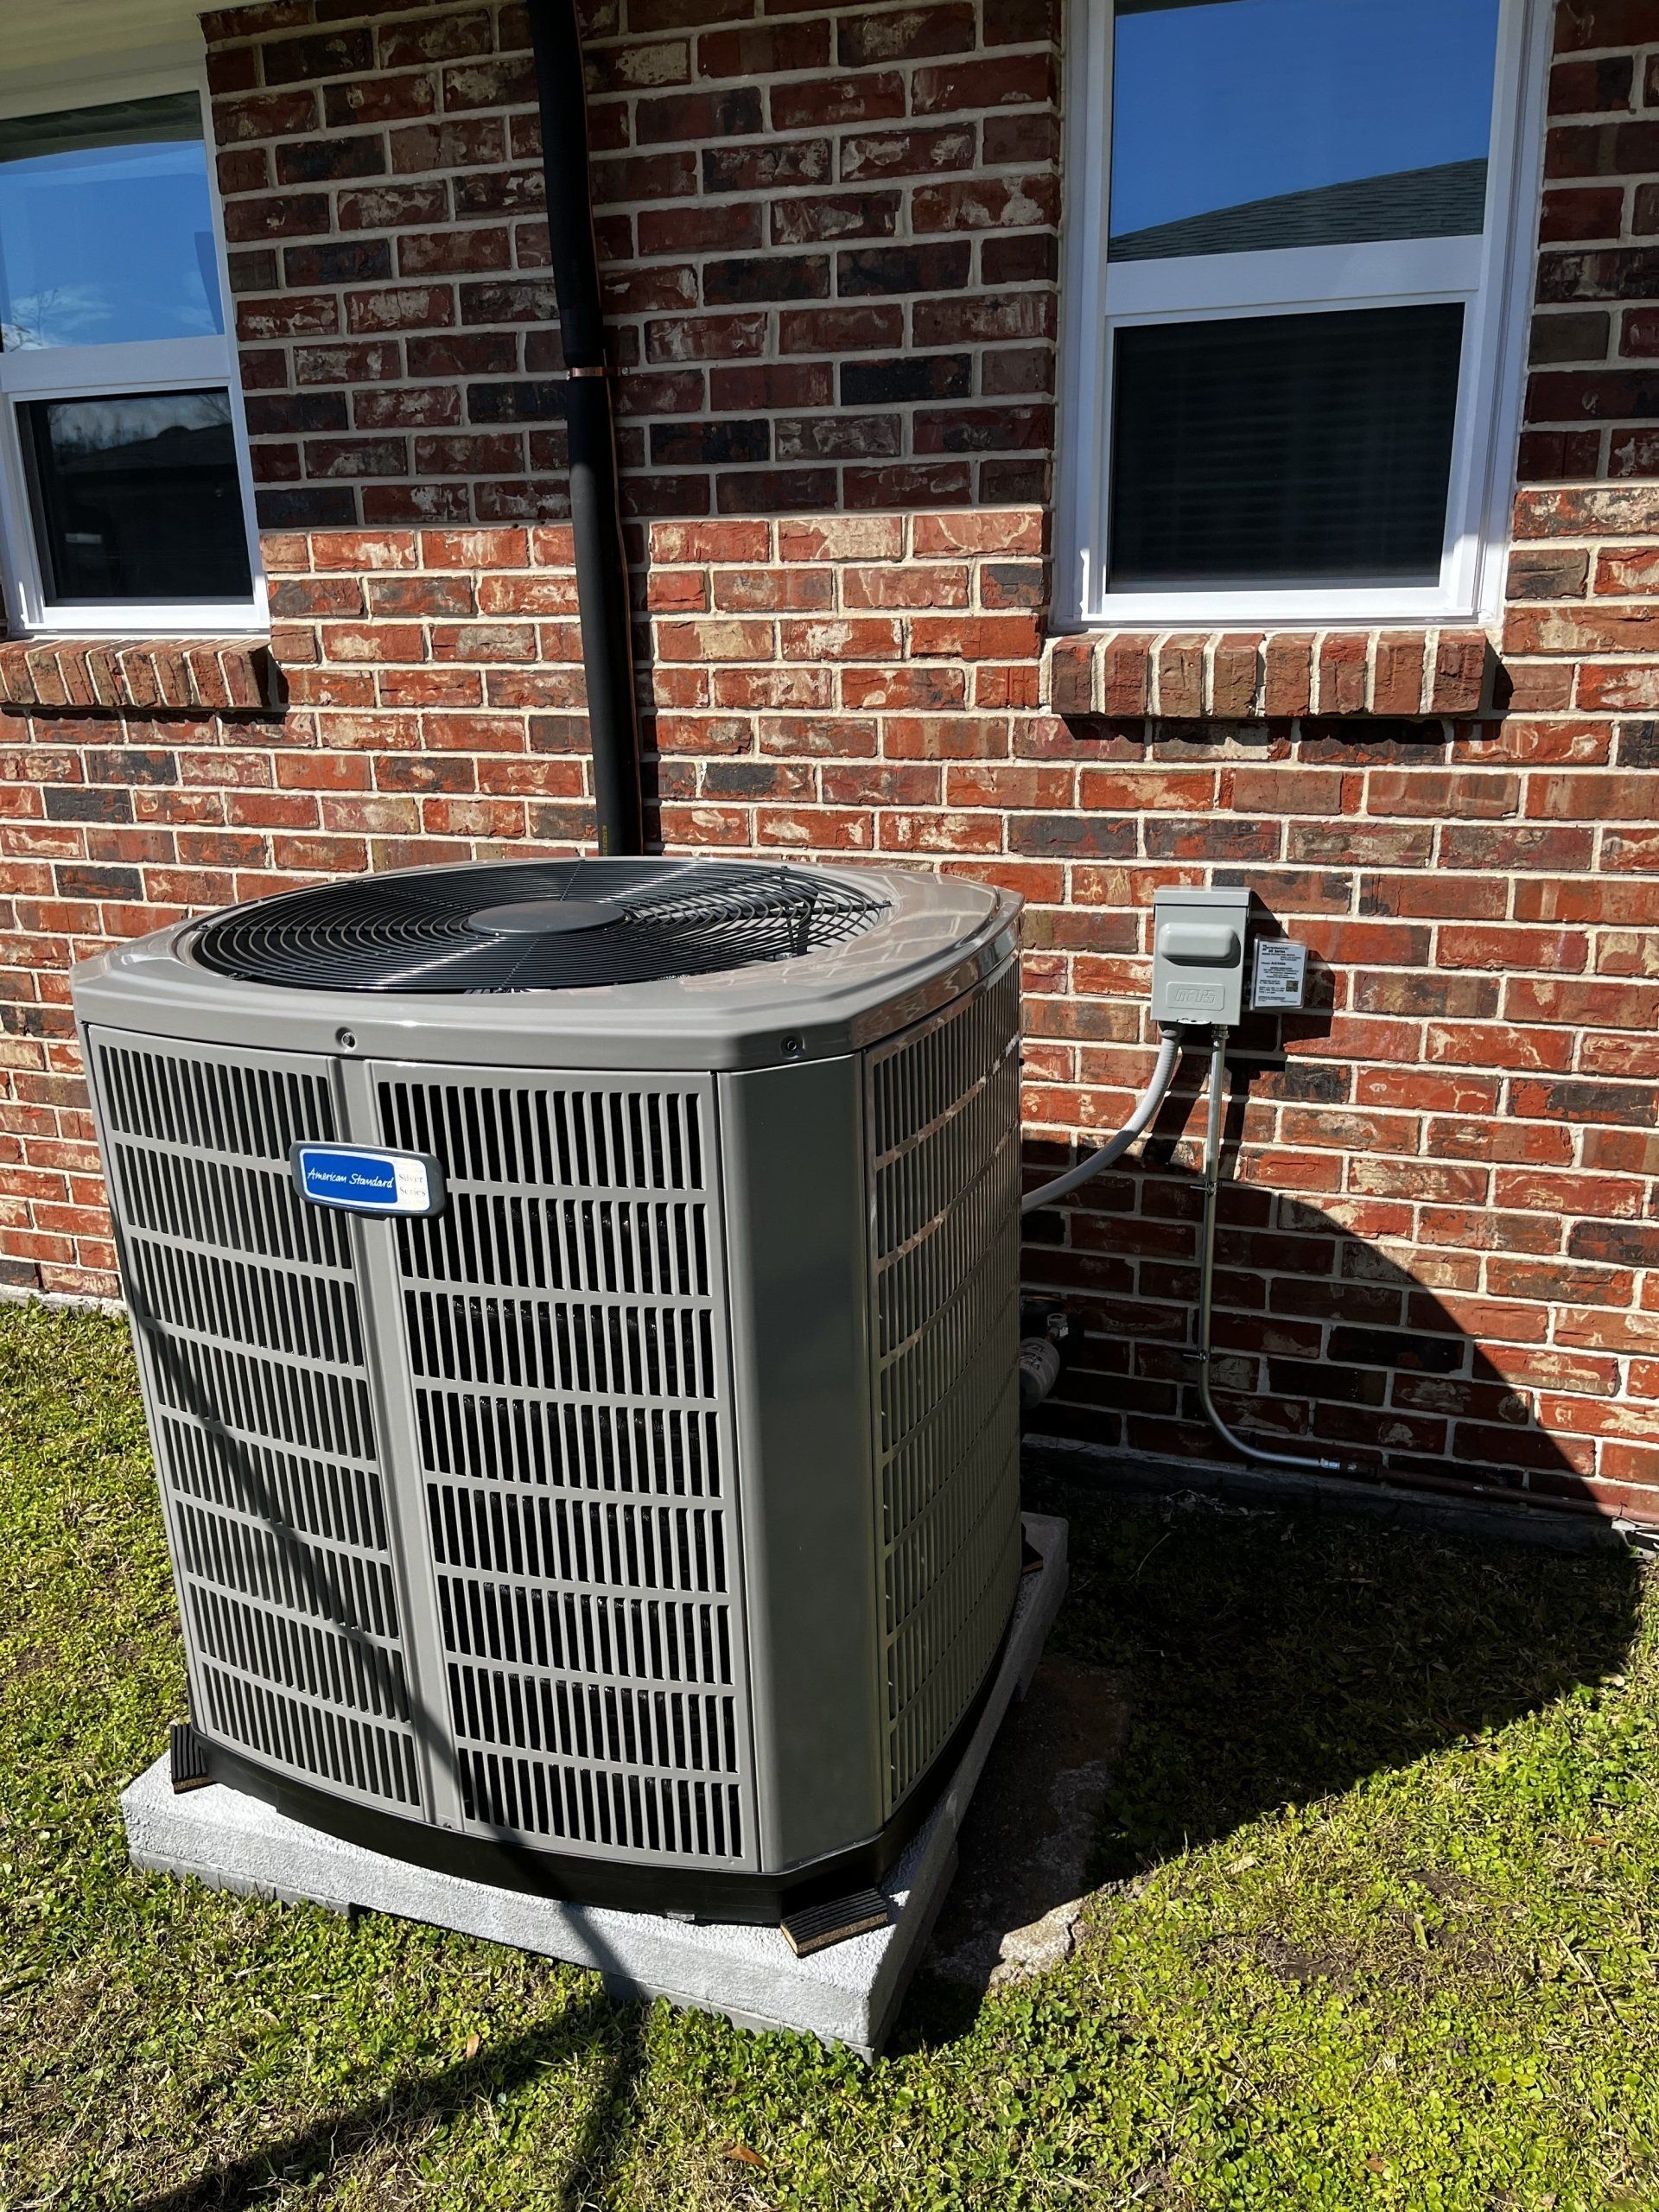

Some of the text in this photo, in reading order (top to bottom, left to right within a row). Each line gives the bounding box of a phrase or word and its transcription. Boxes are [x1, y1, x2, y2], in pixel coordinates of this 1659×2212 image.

[307, 1167, 394, 1189] American Standard
[398, 1173, 423, 1183] Silver
[399, 1186, 426, 1197] Series
